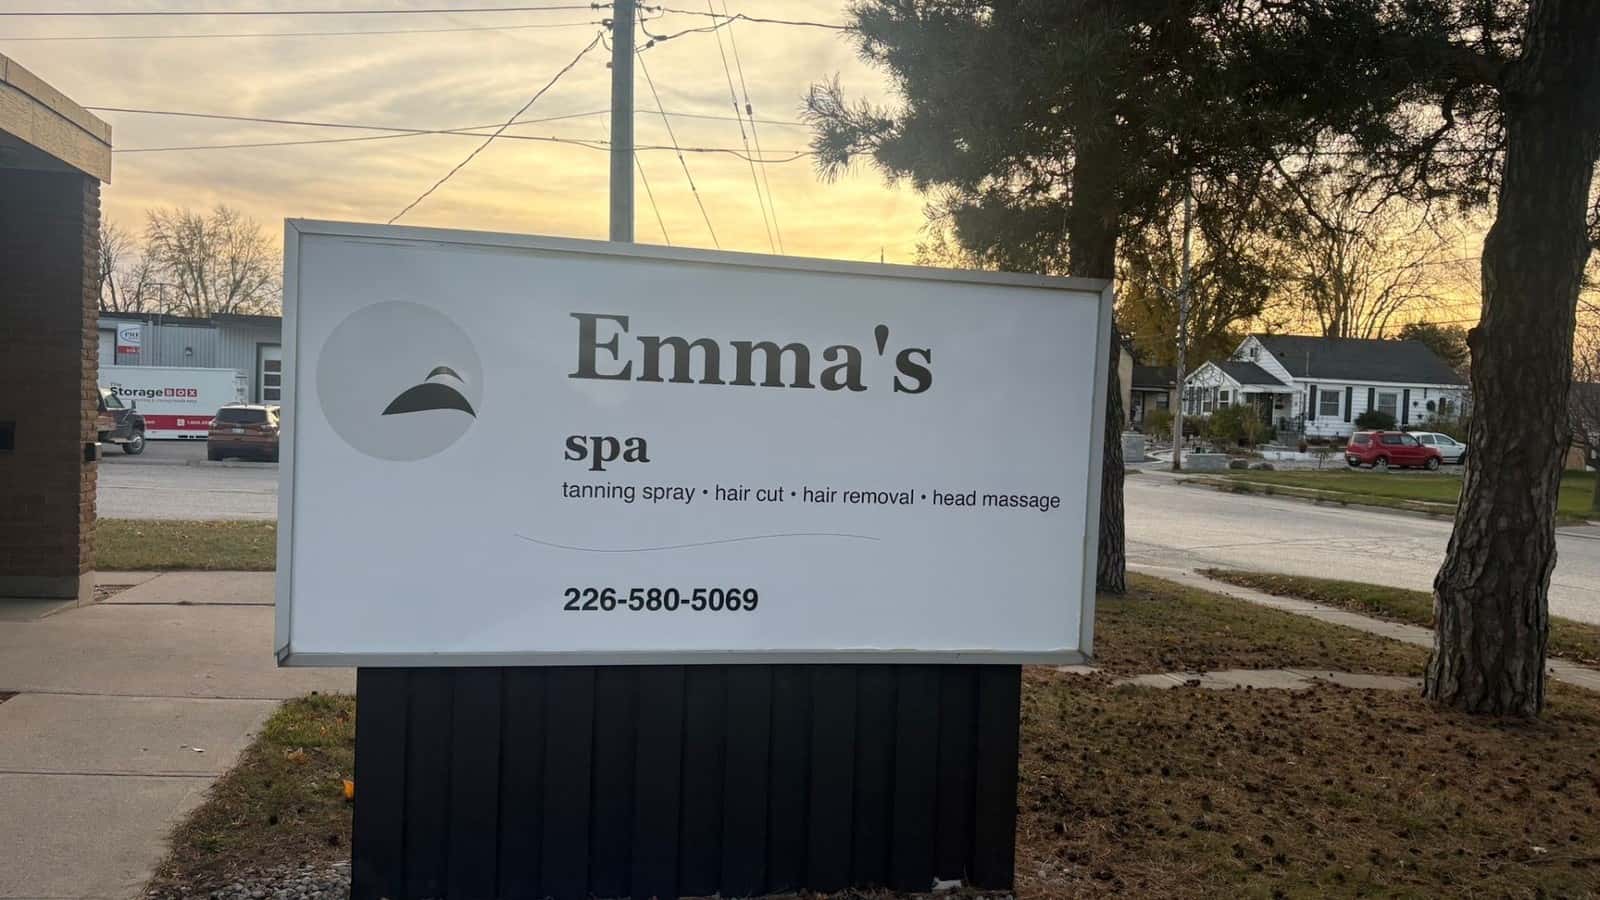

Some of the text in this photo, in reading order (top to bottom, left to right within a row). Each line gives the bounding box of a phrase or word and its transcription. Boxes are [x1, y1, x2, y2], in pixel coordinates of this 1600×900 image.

[567, 312, 933, 395] Emma's
[564, 434, 651, 472] spa
[562, 481, 1061, 513] tanning spray hair cut hair removal head massage
[563, 587, 759, 612] 226-580-5069
